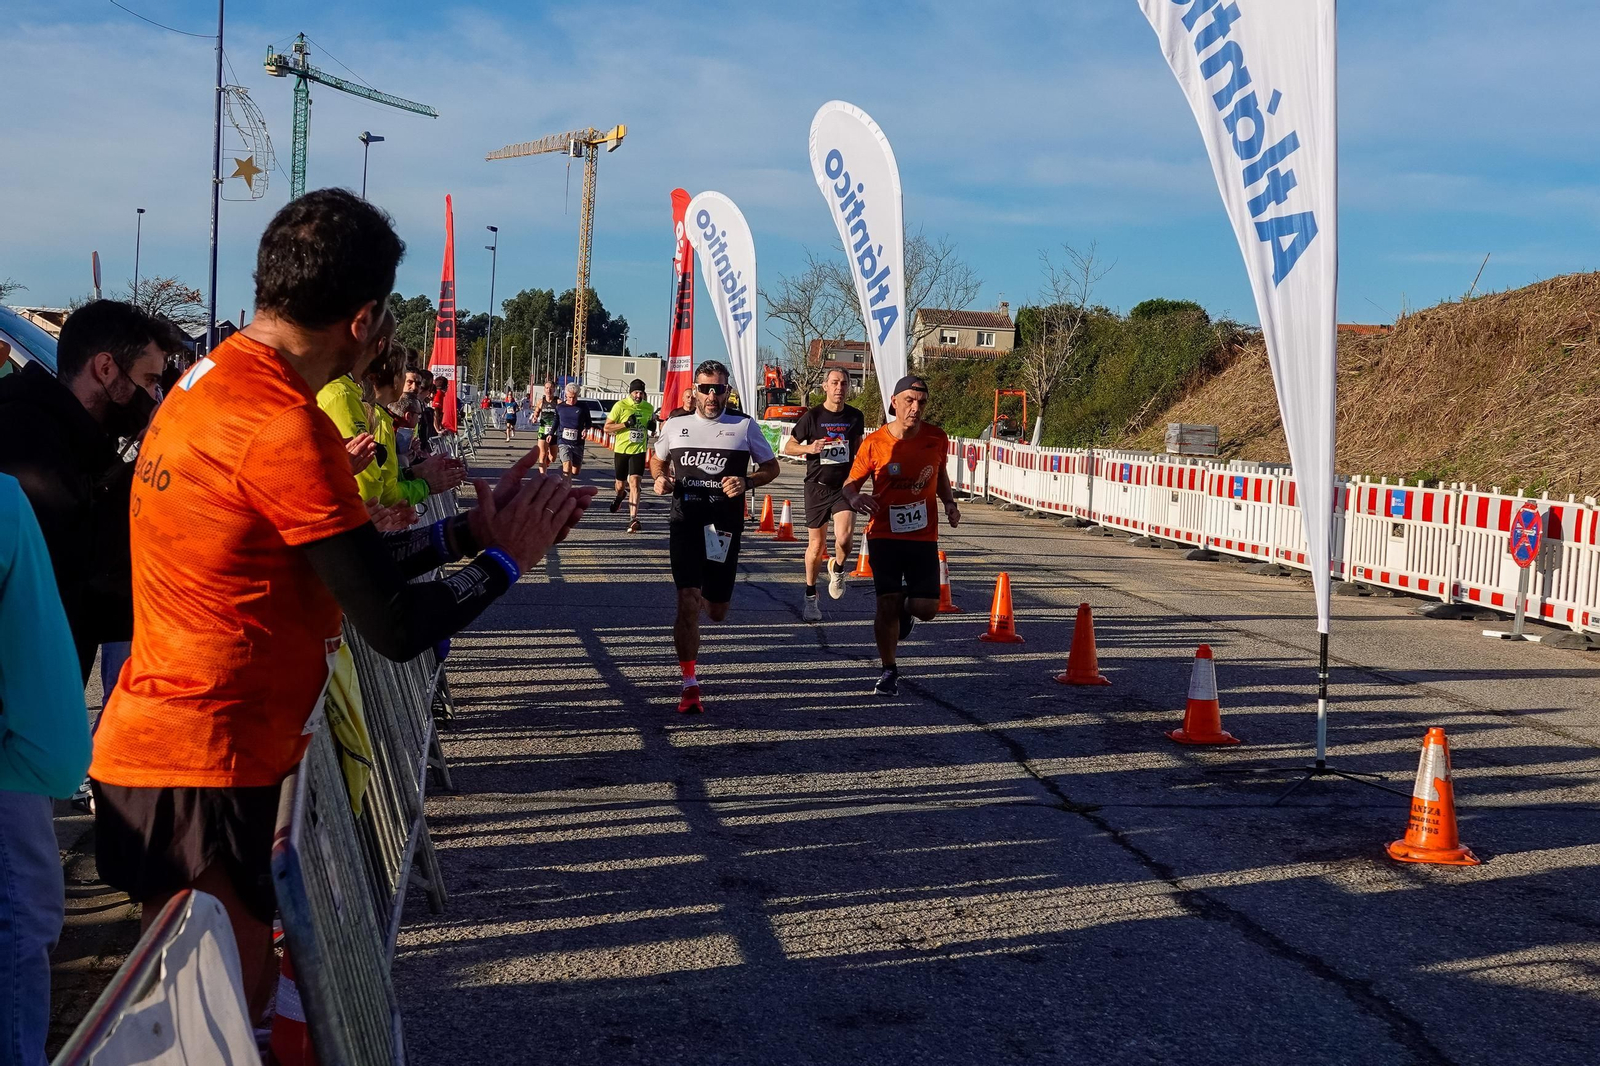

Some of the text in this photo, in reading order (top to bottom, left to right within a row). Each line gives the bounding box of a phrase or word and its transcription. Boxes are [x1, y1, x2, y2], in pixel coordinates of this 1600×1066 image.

[680, 451, 727, 467] delikia
[823, 447, 847, 457] 704
[896, 509, 922, 524] 314
